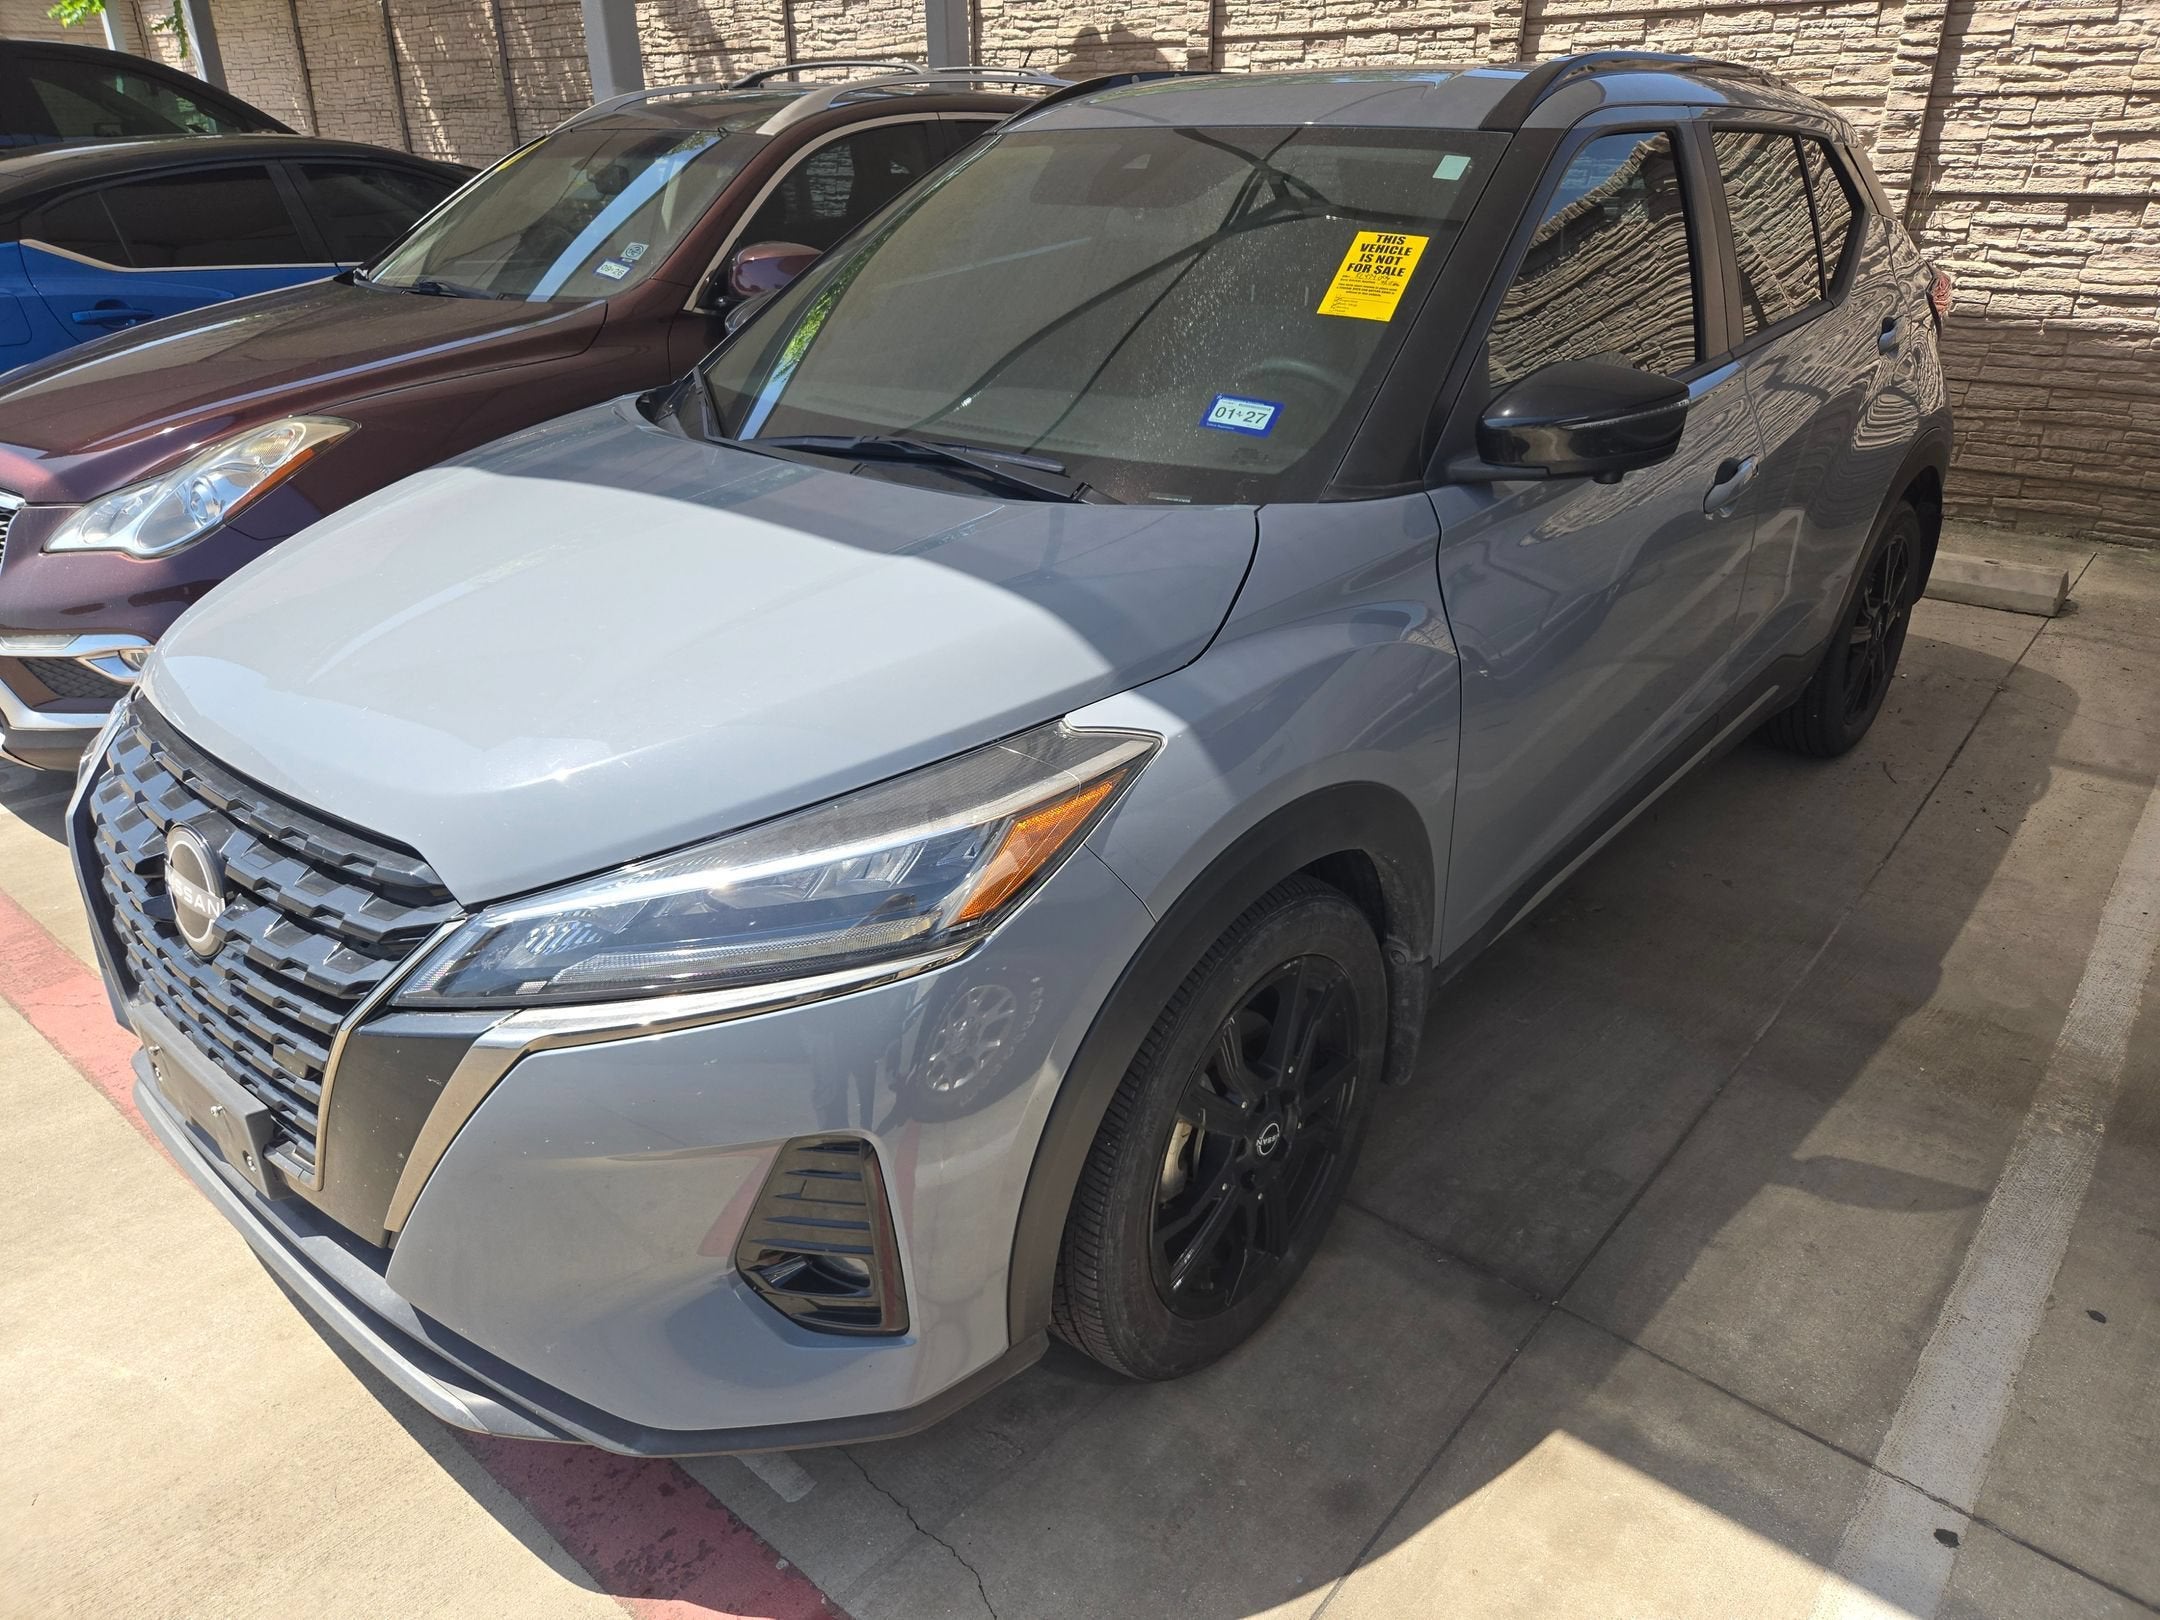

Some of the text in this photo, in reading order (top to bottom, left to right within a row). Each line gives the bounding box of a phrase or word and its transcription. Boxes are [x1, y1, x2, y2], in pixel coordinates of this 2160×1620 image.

[1376, 234, 1407, 245] THIS
[1360, 243, 1413, 256] VEHICLE
[1359, 253, 1404, 265] IS NOT
[1346, 262, 1373, 273] FOR
[1374, 264, 1406, 277] SALE
[1215, 406, 1236, 420] 01
[1242, 411, 1268, 424] 27
